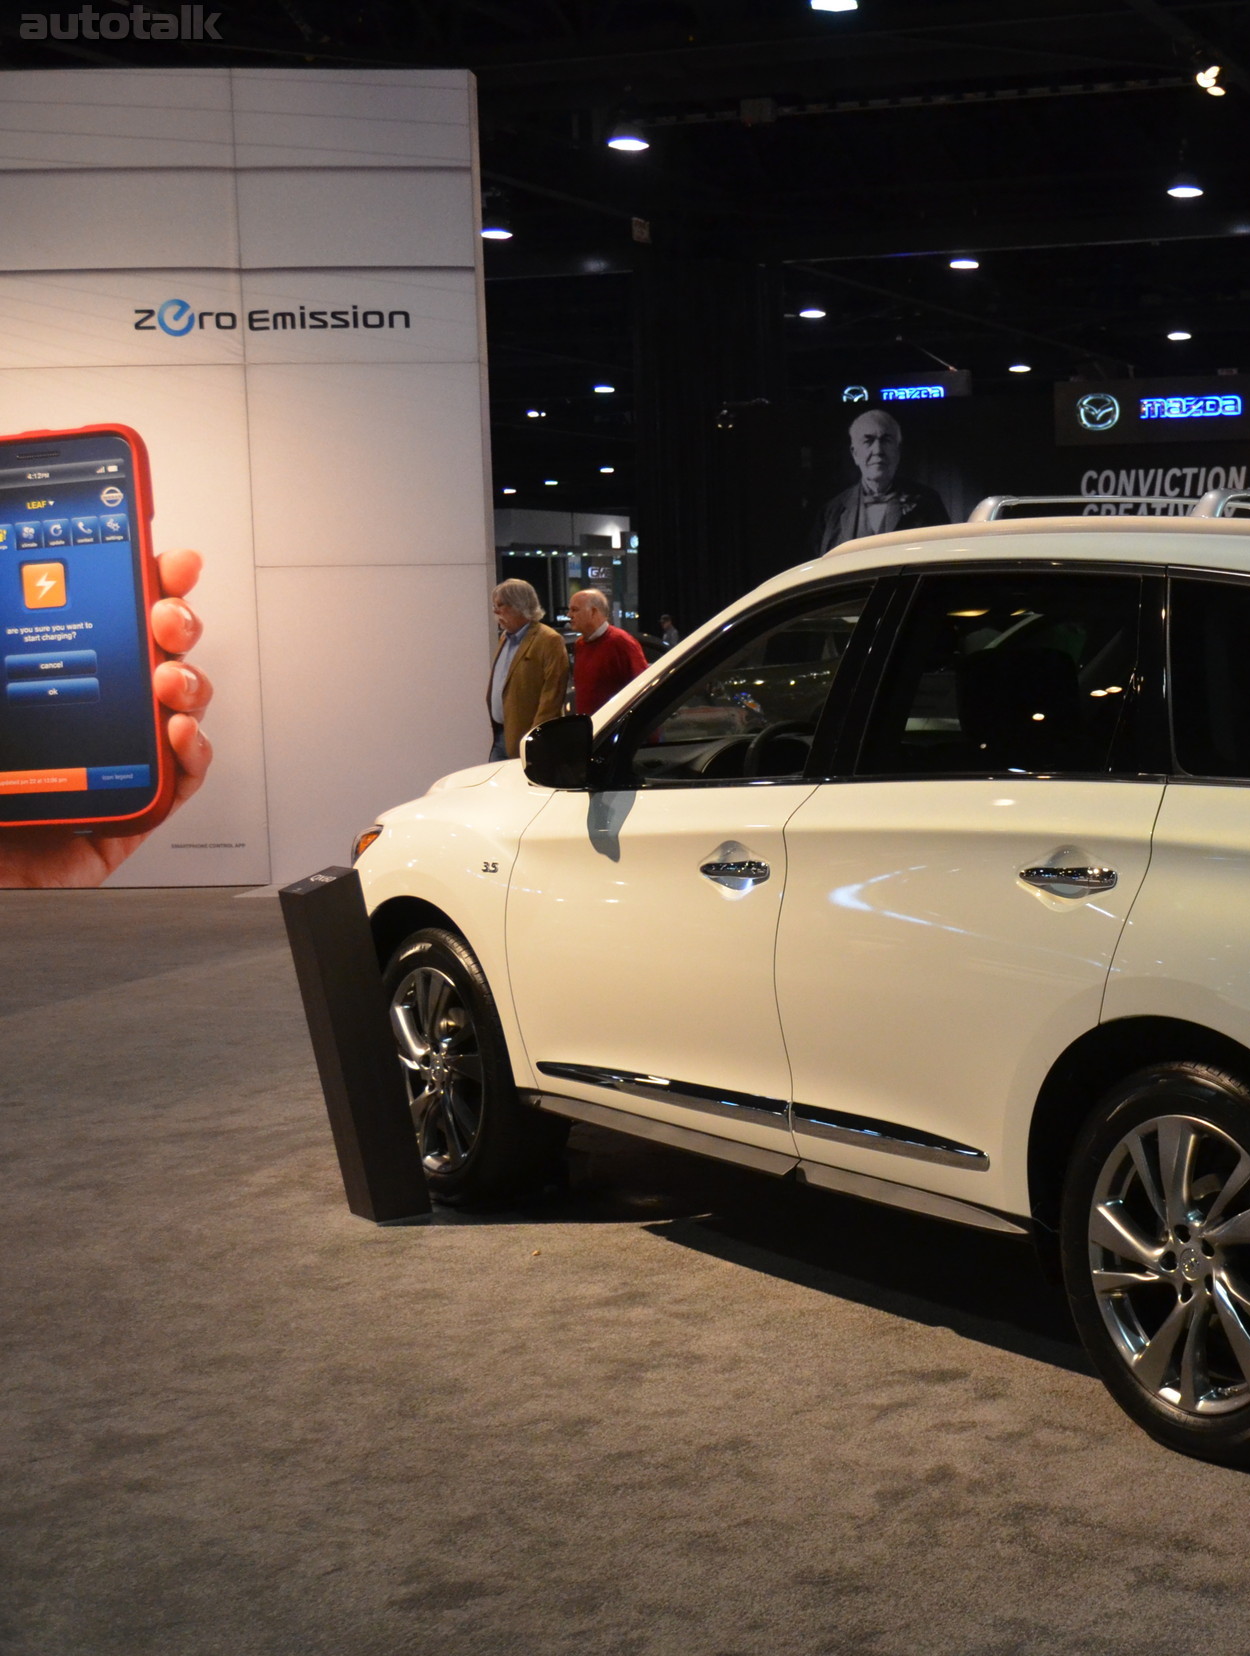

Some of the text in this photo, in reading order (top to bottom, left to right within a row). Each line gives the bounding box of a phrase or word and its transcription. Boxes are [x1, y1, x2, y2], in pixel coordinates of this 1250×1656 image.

[248, 305, 411, 331] Emission
[1139, 394, 1242, 420] mazda
[26, 501, 47, 510] LEAF
[20, 627, 33, 635] you
[51, 625, 65, 633] you
[41, 631, 77, 641] charging?
[40, 661, 63, 669] cancel
